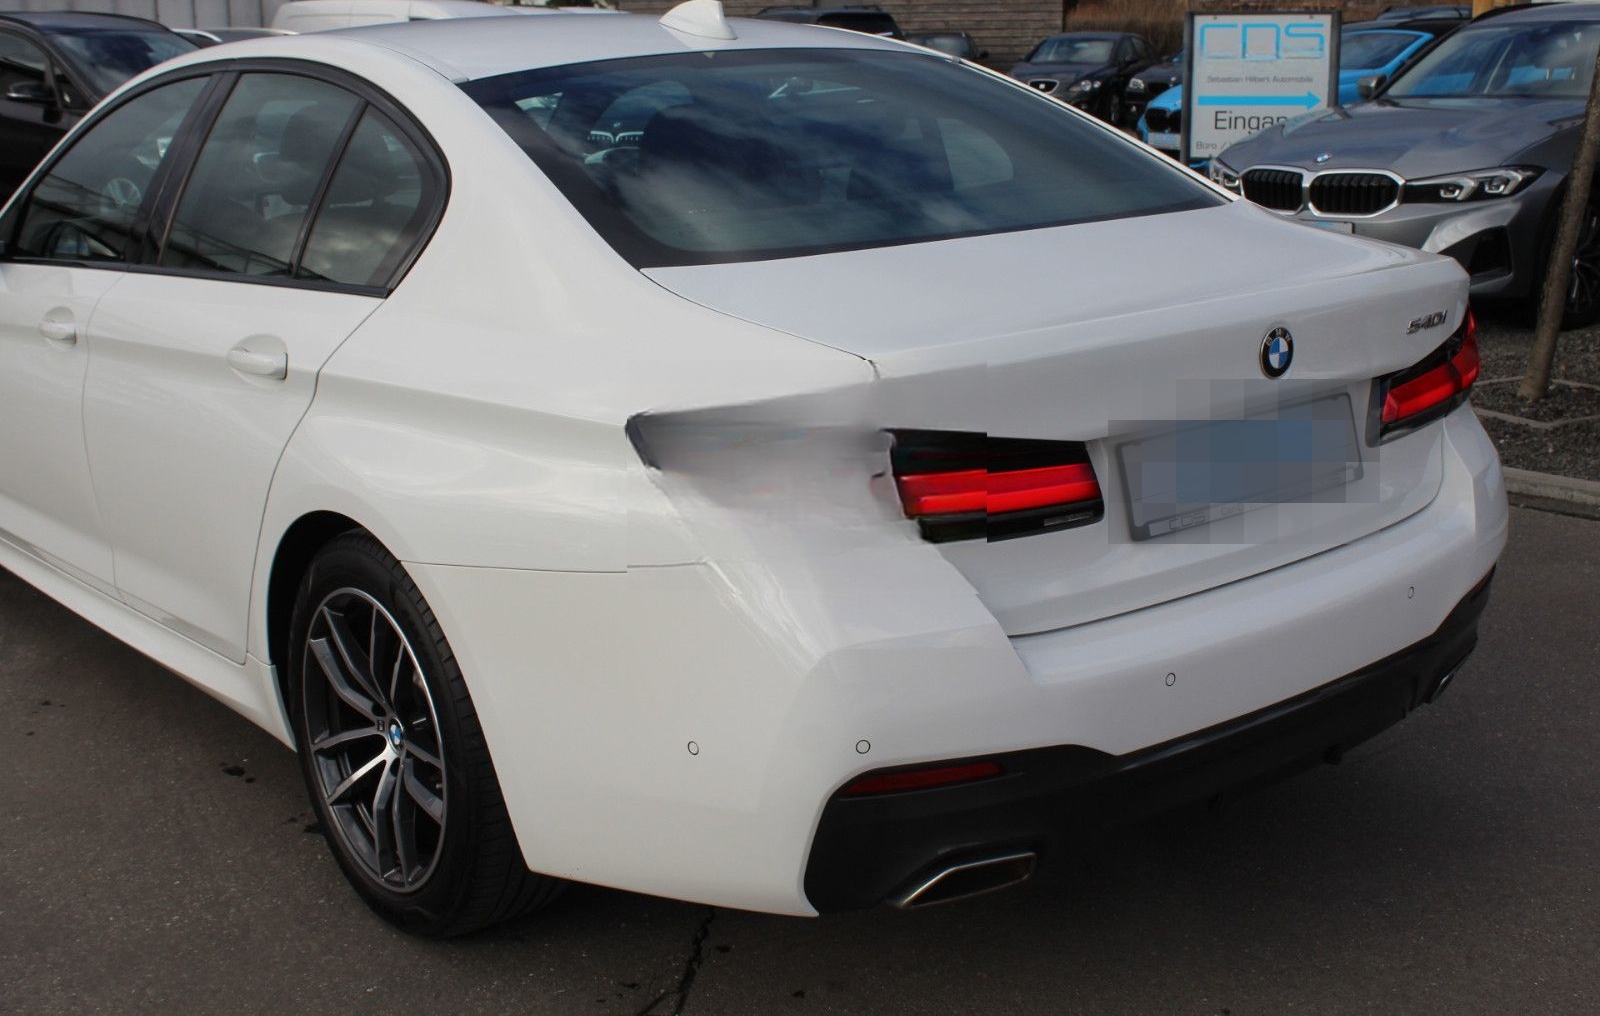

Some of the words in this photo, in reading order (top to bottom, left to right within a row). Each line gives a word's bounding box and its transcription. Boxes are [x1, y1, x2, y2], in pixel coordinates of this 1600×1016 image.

[1207, 75, 1243, 84] Sebastian
[1272, 75, 1314, 84] Automobile
[1195, 140, 1217, 150] Büro
[1406, 309, 1448, 335] 540i
